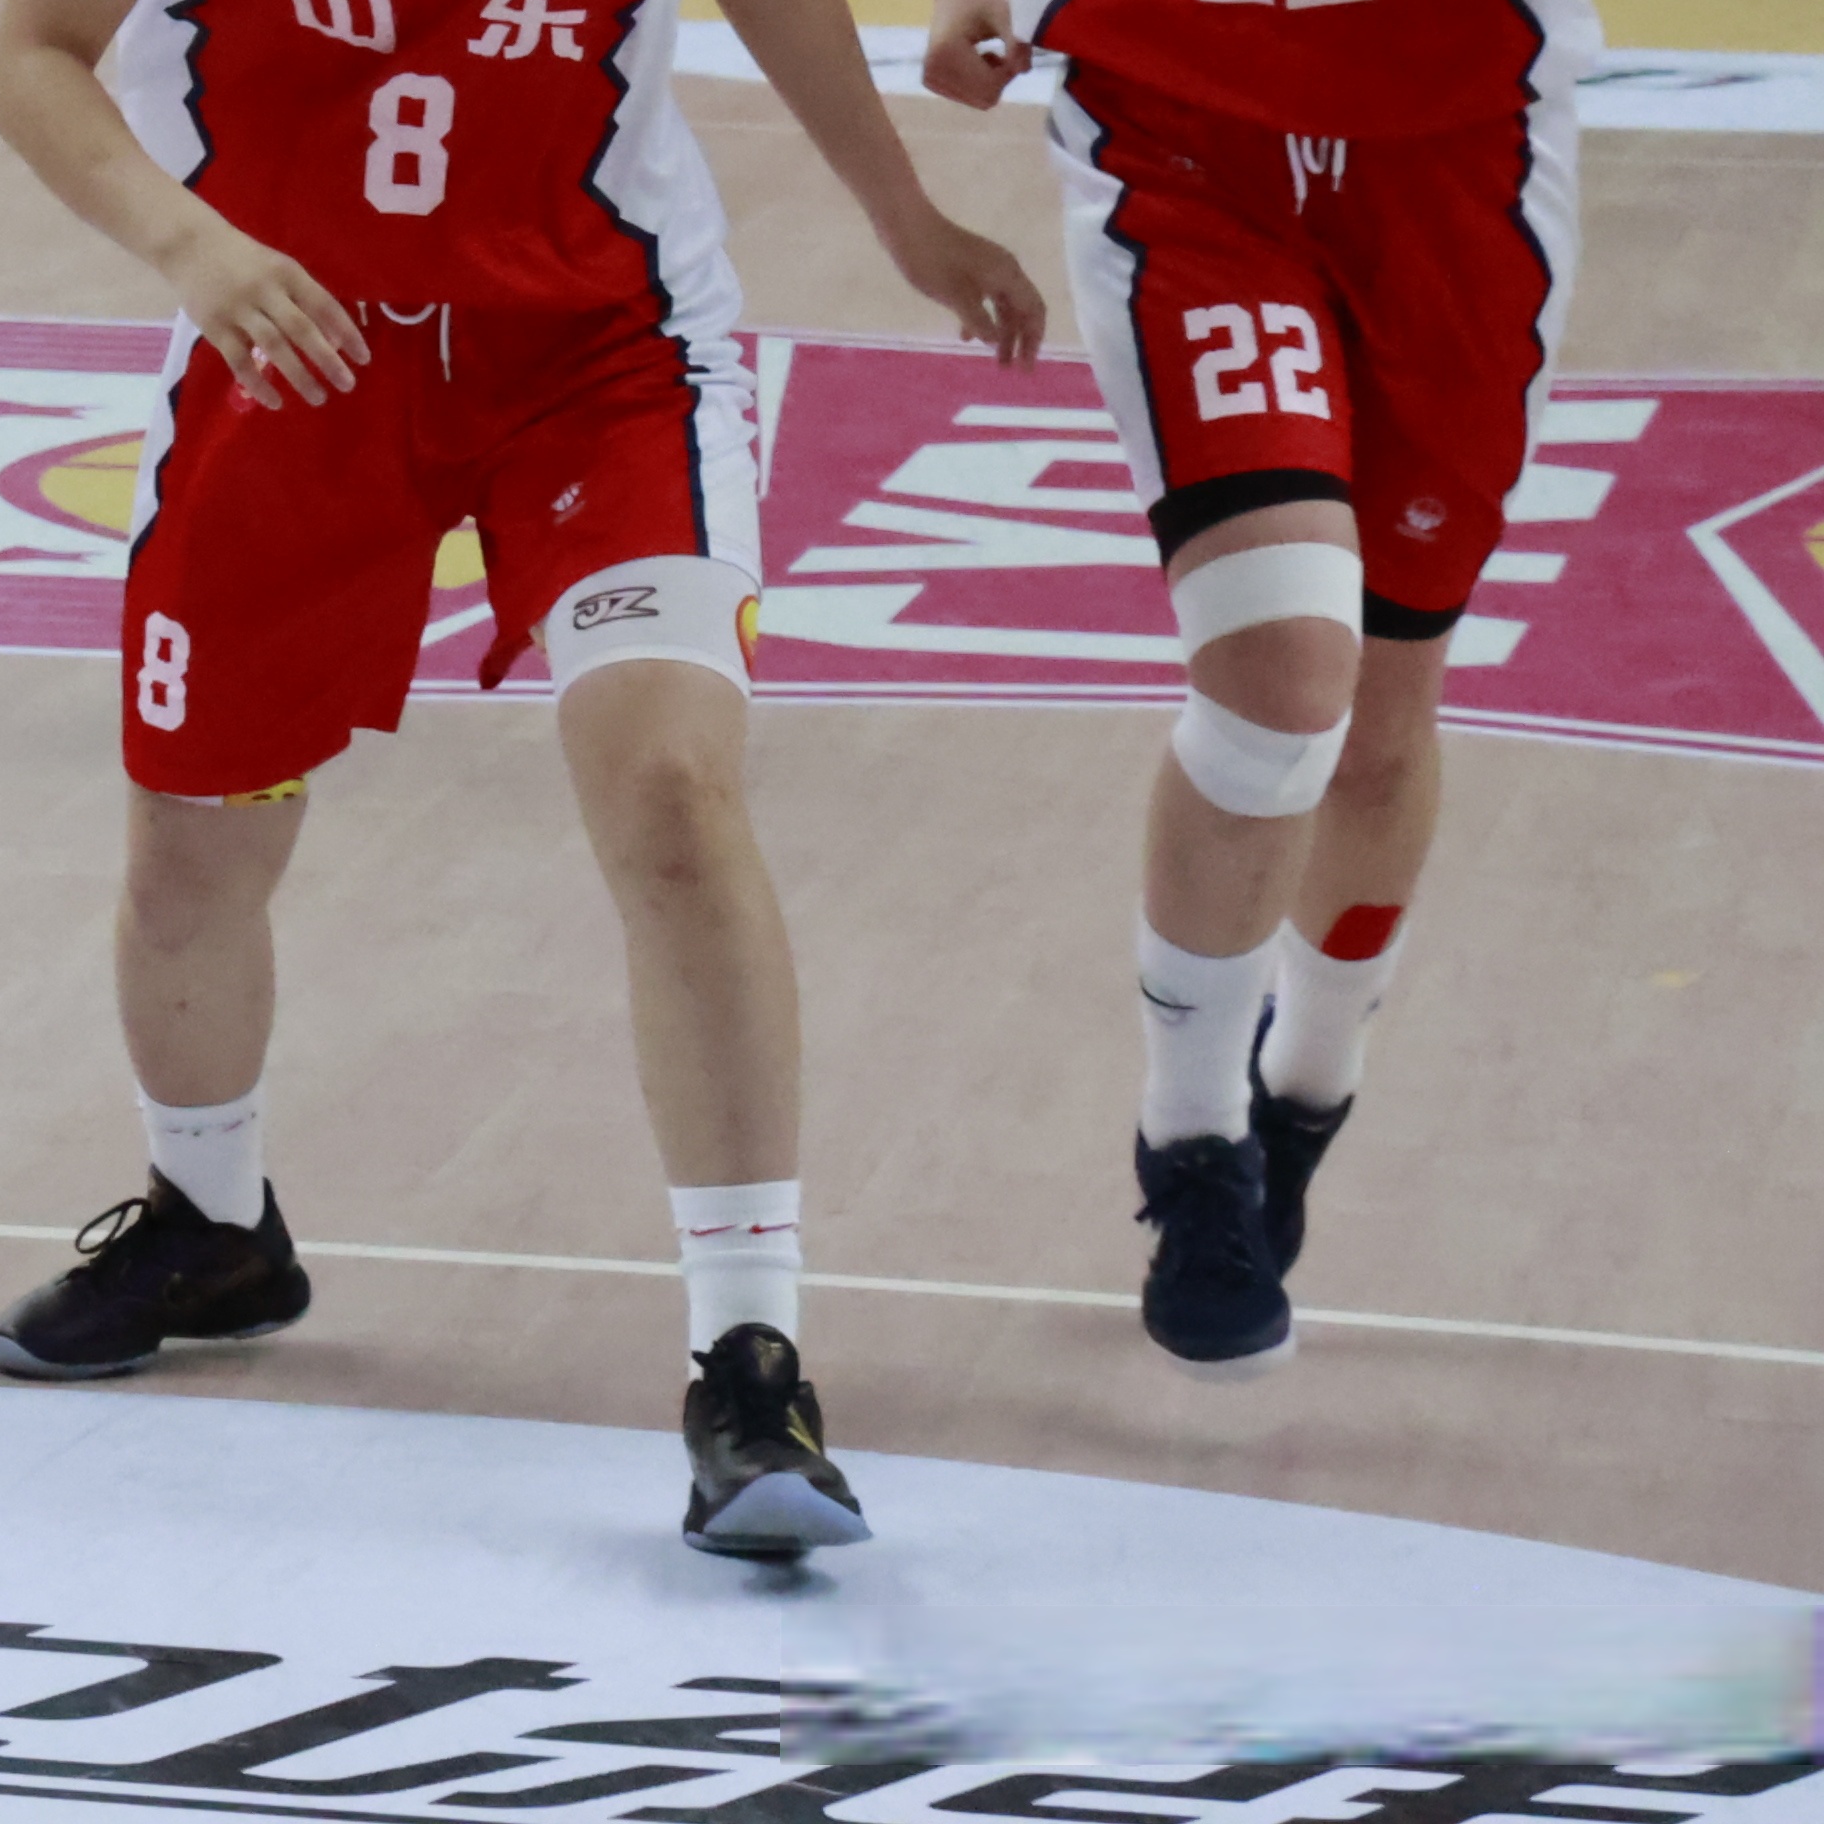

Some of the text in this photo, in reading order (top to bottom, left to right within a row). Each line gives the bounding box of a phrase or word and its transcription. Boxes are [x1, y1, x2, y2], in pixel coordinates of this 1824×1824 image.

[363, 72, 455, 216] 8
[1183, 302, 1332, 423] 22
[137, 611, 191, 732] 8
